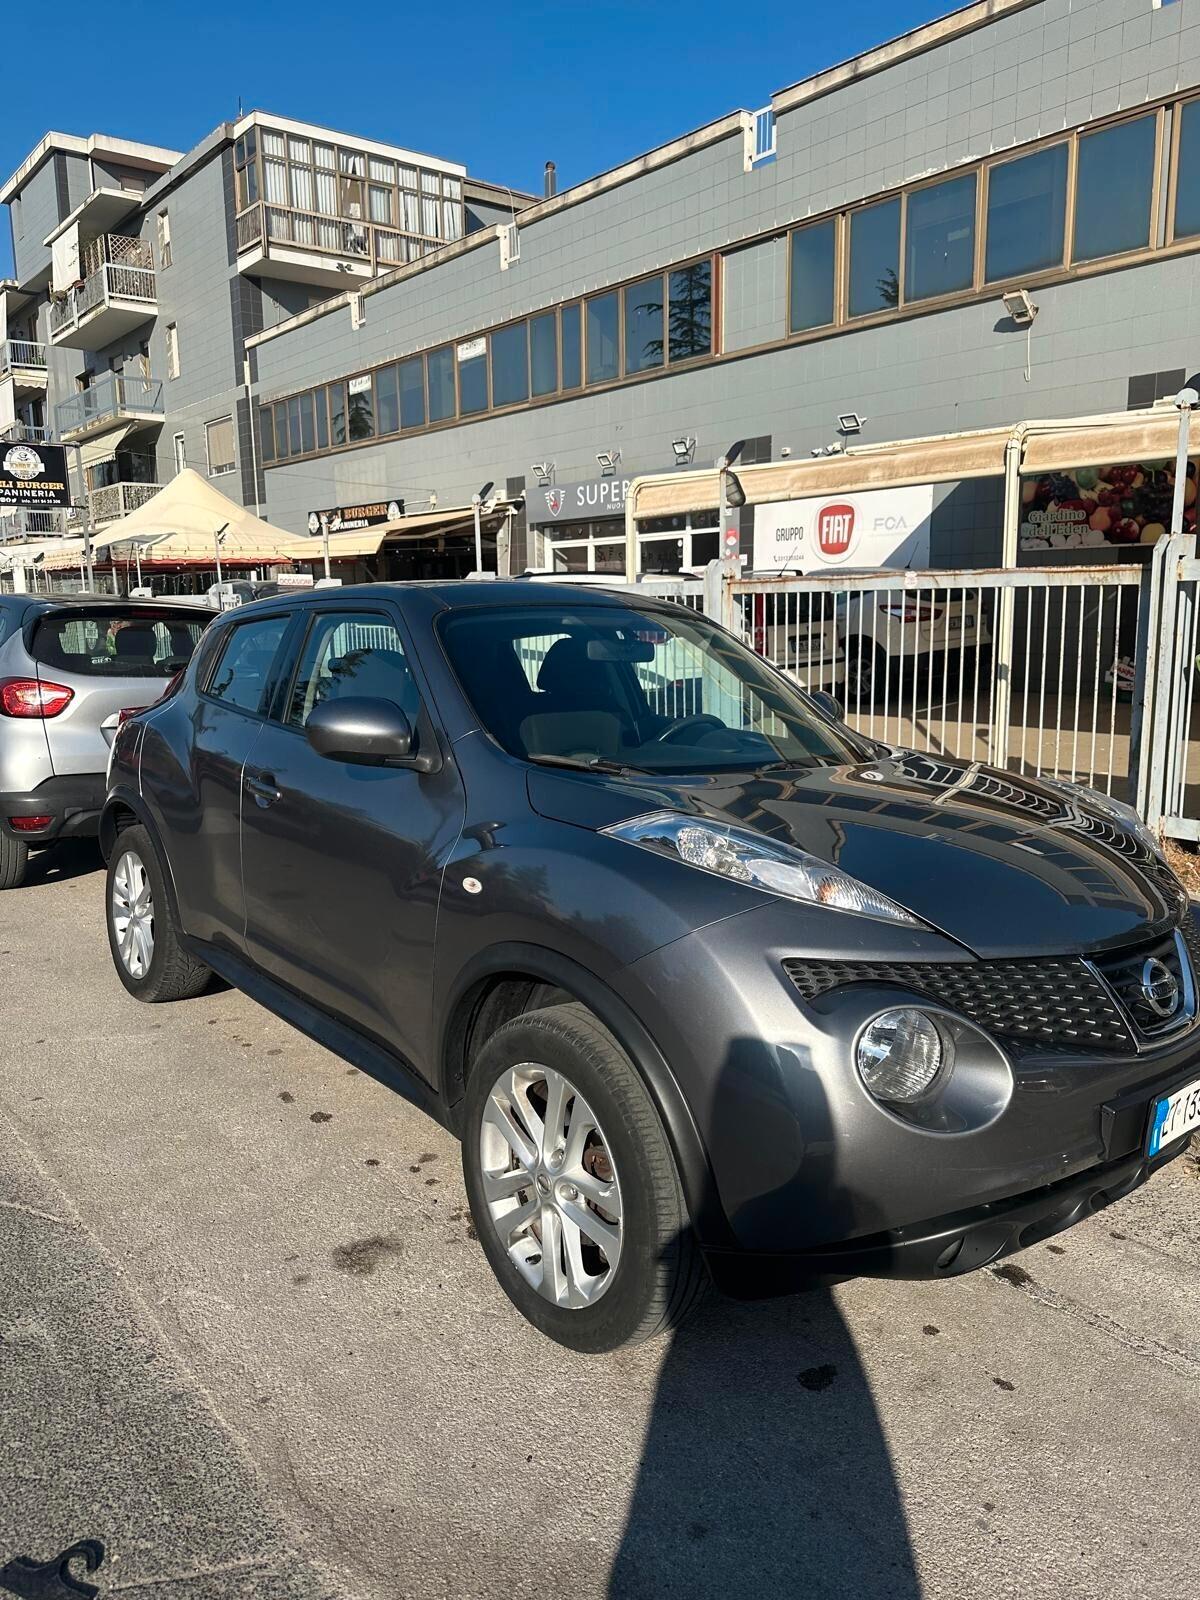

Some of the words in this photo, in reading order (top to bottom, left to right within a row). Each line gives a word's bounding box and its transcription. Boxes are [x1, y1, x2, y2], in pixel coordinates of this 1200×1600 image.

[16, 481, 65, 490] BURGER
[343, 503, 388, 519] BURGER
[1028, 509, 1086, 523] Giardino
[776, 526, 804, 542] GRUPPO
[821, 513, 852, 545] FIAT
[873, 516, 907, 531] FCA
